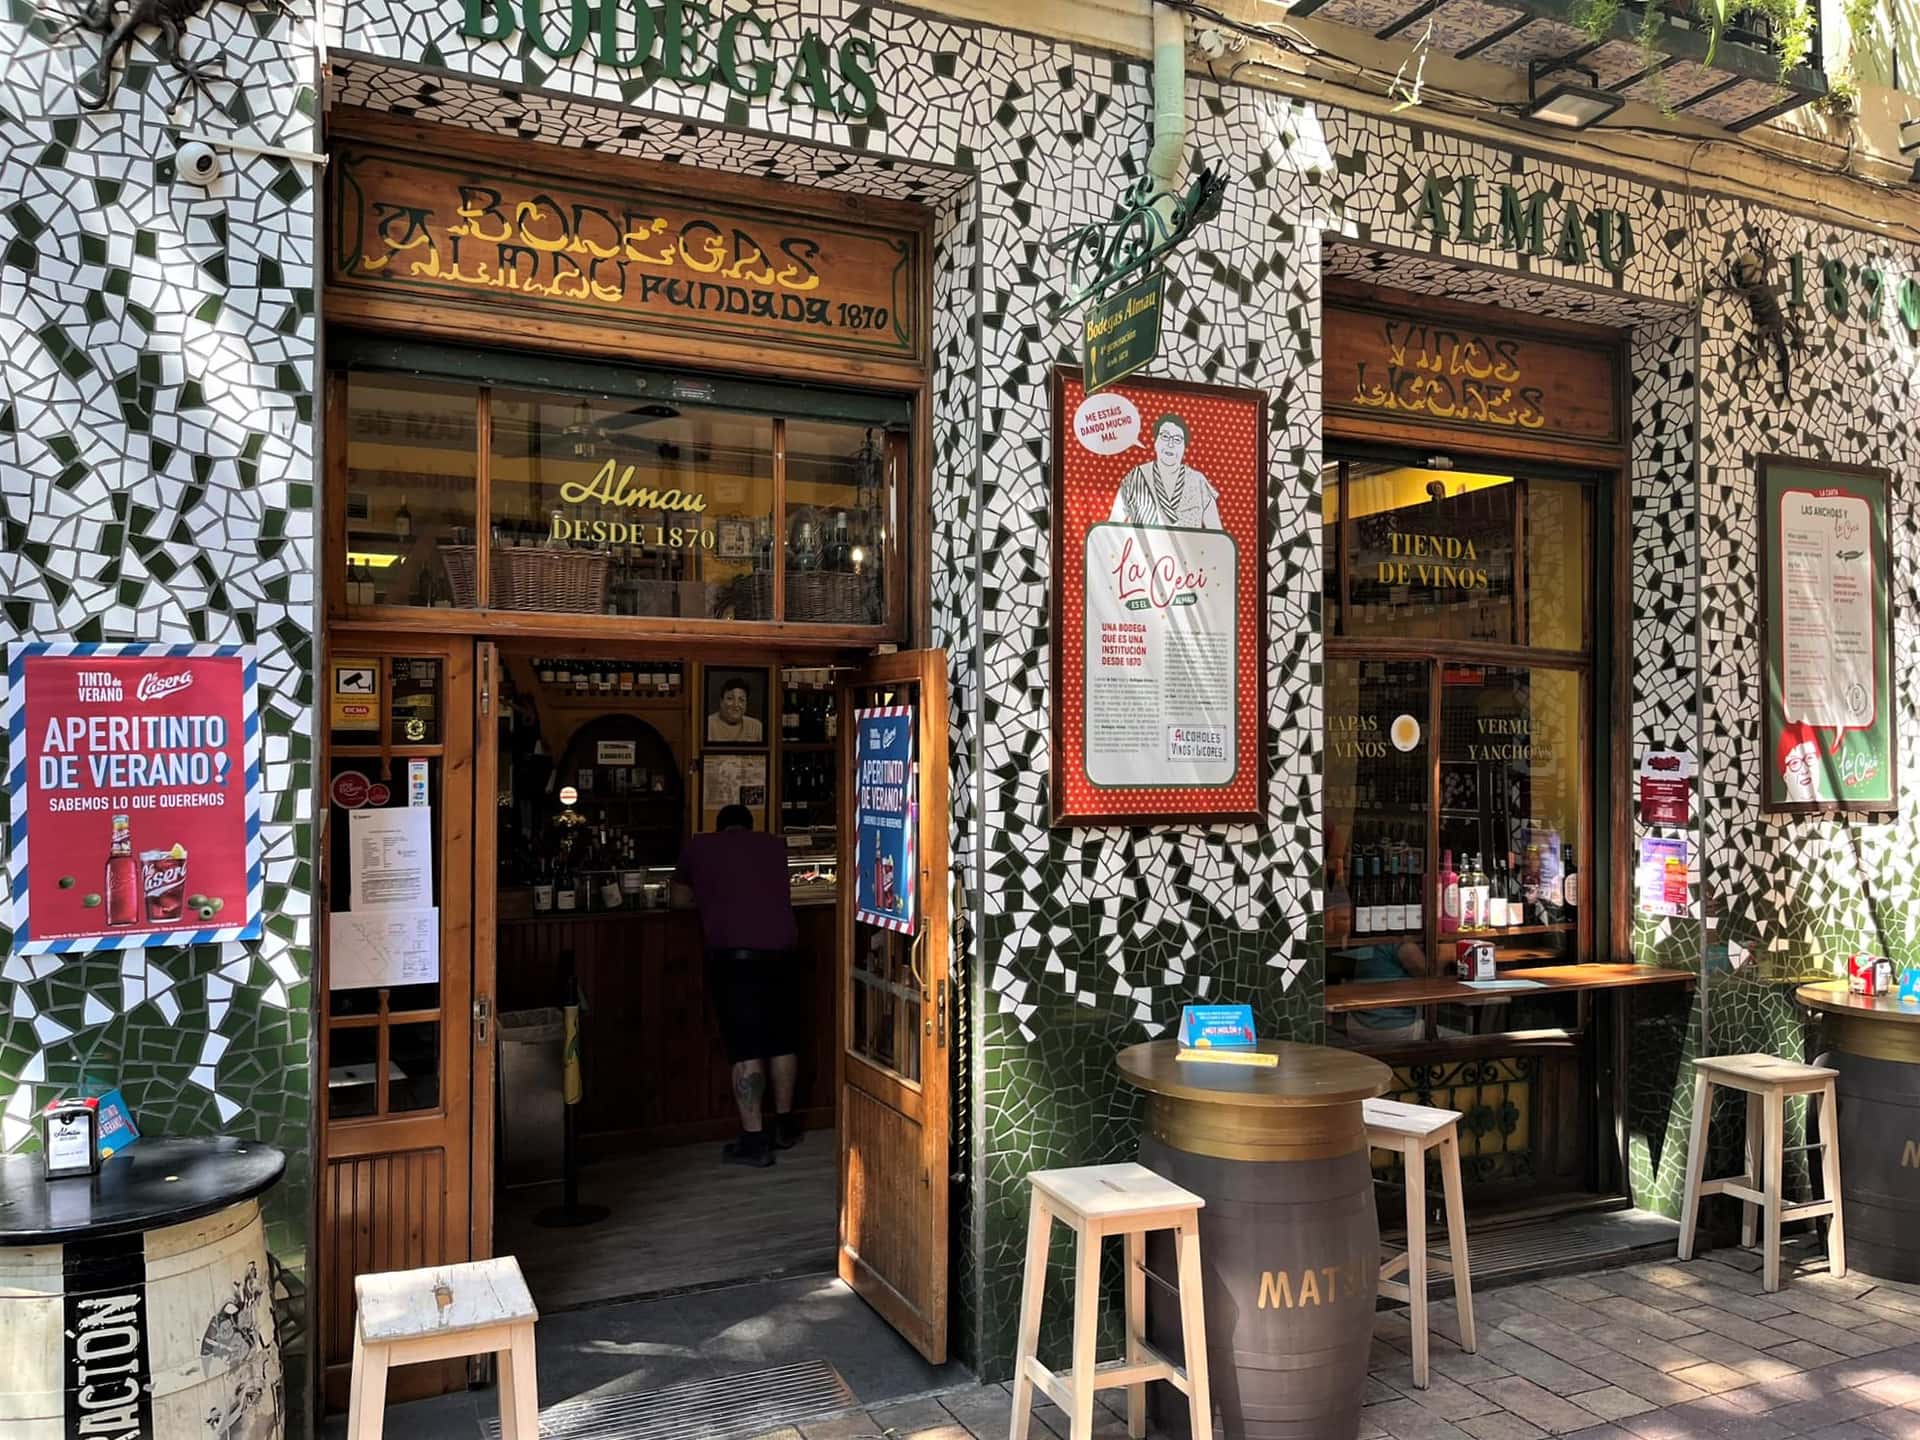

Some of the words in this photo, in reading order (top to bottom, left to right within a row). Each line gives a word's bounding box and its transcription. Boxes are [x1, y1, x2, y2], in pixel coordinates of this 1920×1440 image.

[1415, 170, 1634, 273] ALMAU
[449, 185, 821, 291] BODEGAS
[838, 302, 889, 330] 1870
[1087, 310, 1123, 342] Bodegas
[1124, 291, 1156, 320] Almau
[1385, 320, 1520, 382] VINOS
[1352, 361, 1545, 428] LICORES
[1080, 422, 1105, 436] DANDO
[1106, 415, 1132, 429] MUCHO
[1085, 412, 1097, 422] ME
[1101, 432, 1117, 442] MAL
[560, 458, 706, 512] Almau
[551, 517, 645, 546] DESDE
[655, 526, 715, 550] 1870
[1387, 531, 1477, 561] TIENDA
[1112, 537, 1146, 599] La
[1150, 555, 1208, 609] Ceci
[1378, 561, 1411, 585] DE
[1417, 564, 1488, 590] VINOS
[1102, 623, 1116, 632] UNA
[1119, 623, 1147, 633] BODEGA
[1102, 634, 1116, 643] QUE
[1118, 634, 1127, 643] ES
[1128, 634, 1143, 643] UNA
[1102, 656, 1124, 666] DESDE
[1125, 656, 1142, 666] 1870
[77, 671, 111, 688] TINTO
[112, 677, 122, 687] de
[78, 687, 123, 702] VERANO
[43, 715, 227, 753] APERITINTO
[1328, 714, 1377, 732] TAPAS
[1174, 729, 1221, 744] ALCOHOLES
[1196, 744, 1222, 758] LICORES
[1335, 741, 1386, 759] VINOS
[39, 755, 81, 790] DE
[88, 752, 230, 789] VERANO!
[862, 760, 903, 785] APERITINTO
[50, 796, 109, 812] SABEMOS
[113, 795, 129, 809] LO
[132, 794, 156, 808] QUE
[160, 793, 225, 807] QUEREMOS
[861, 786, 871, 809] DE
[871, 786, 903, 813] VERANO!
